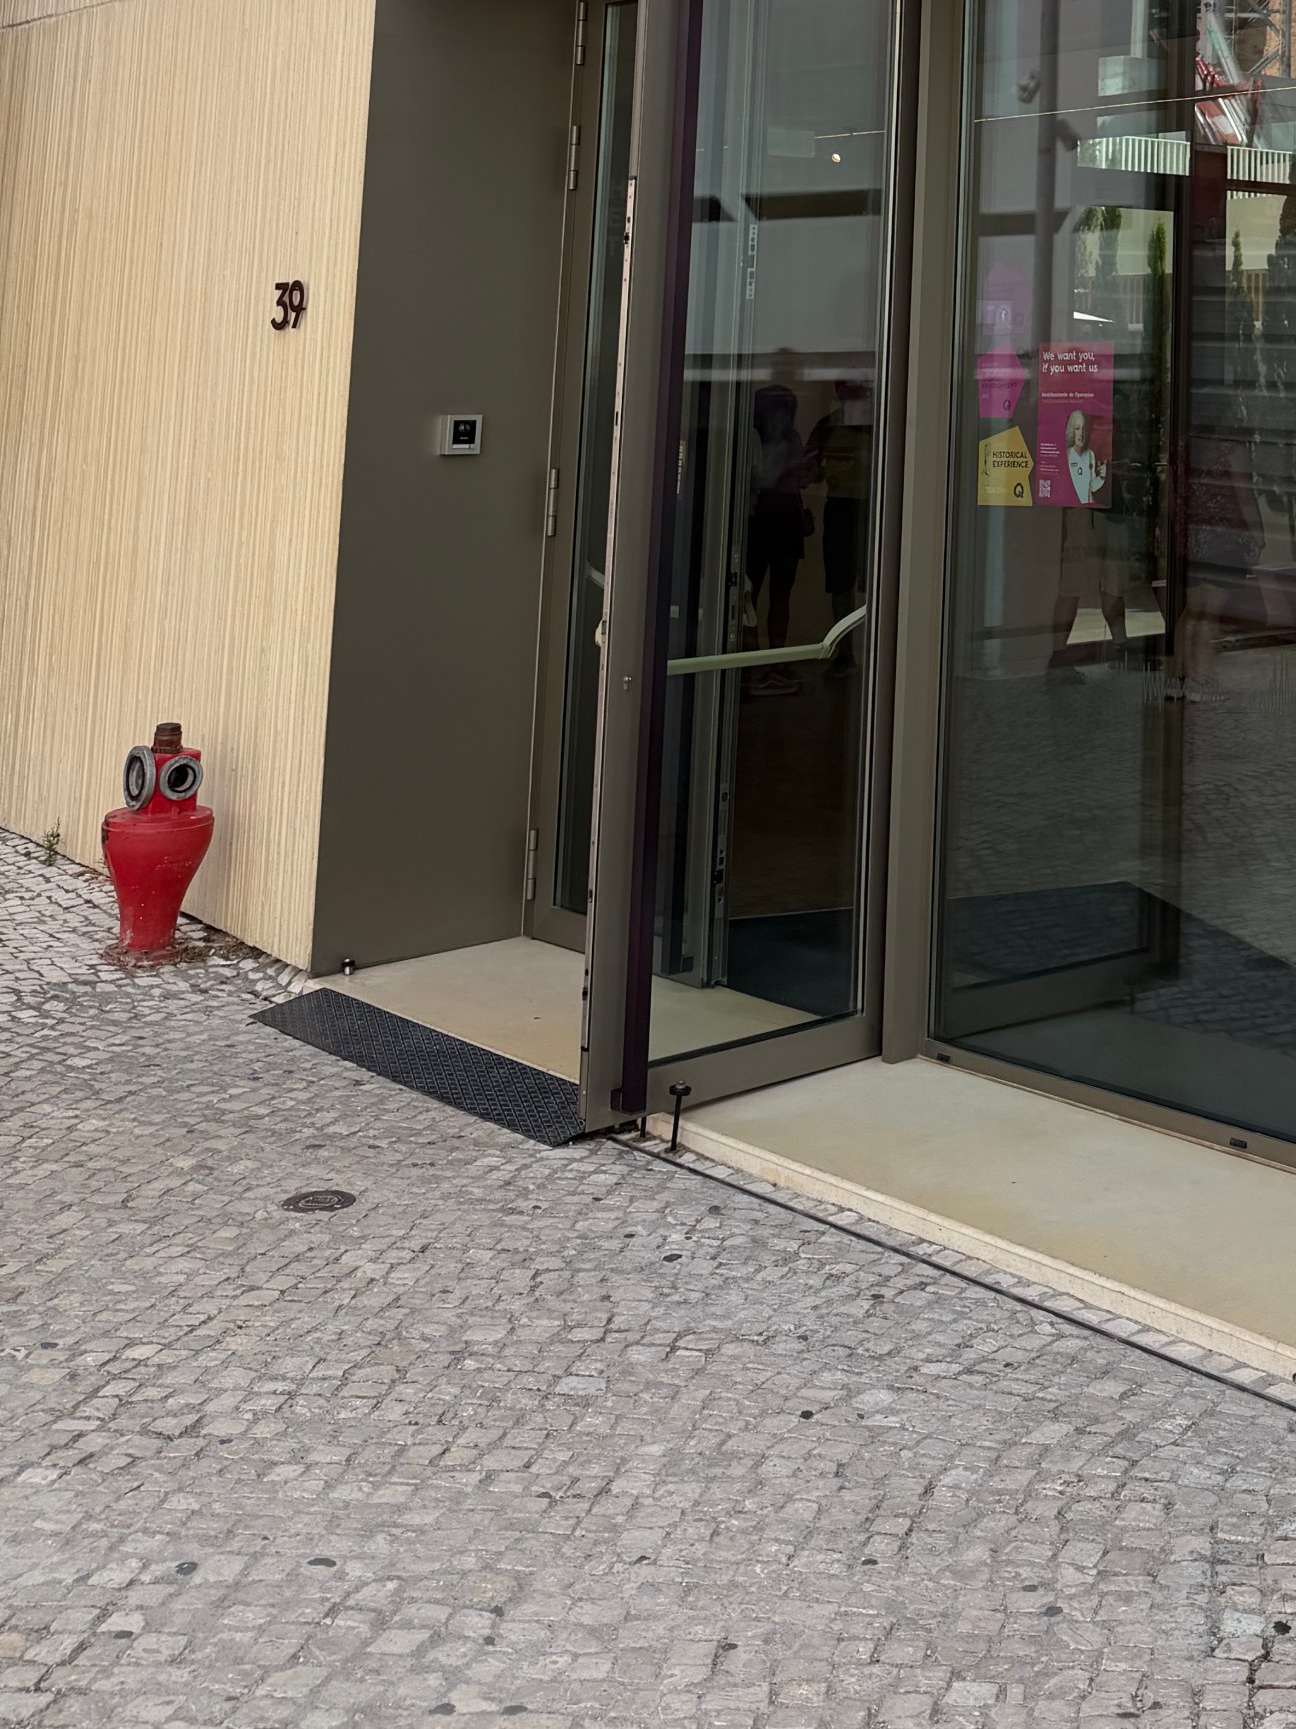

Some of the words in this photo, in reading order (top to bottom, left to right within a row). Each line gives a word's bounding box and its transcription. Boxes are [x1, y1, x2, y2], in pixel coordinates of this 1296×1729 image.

[270, 279, 306, 331] 39
[1042, 351, 1054, 361] We
[1057, 351, 1076, 361] want
[1078, 352, 1096, 363] you,
[1042, 363, 1049, 373] if
[1050, 364, 1065, 375] you
[1067, 364, 1087, 373] want
[1088, 364, 1098, 373] us
[1002, 399, 1011, 411] Q
[992, 450, 1028, 459] HISTORICAL
[992, 459, 1029, 469] EXPERIENCE
[1013, 482, 1024, 499] Q
